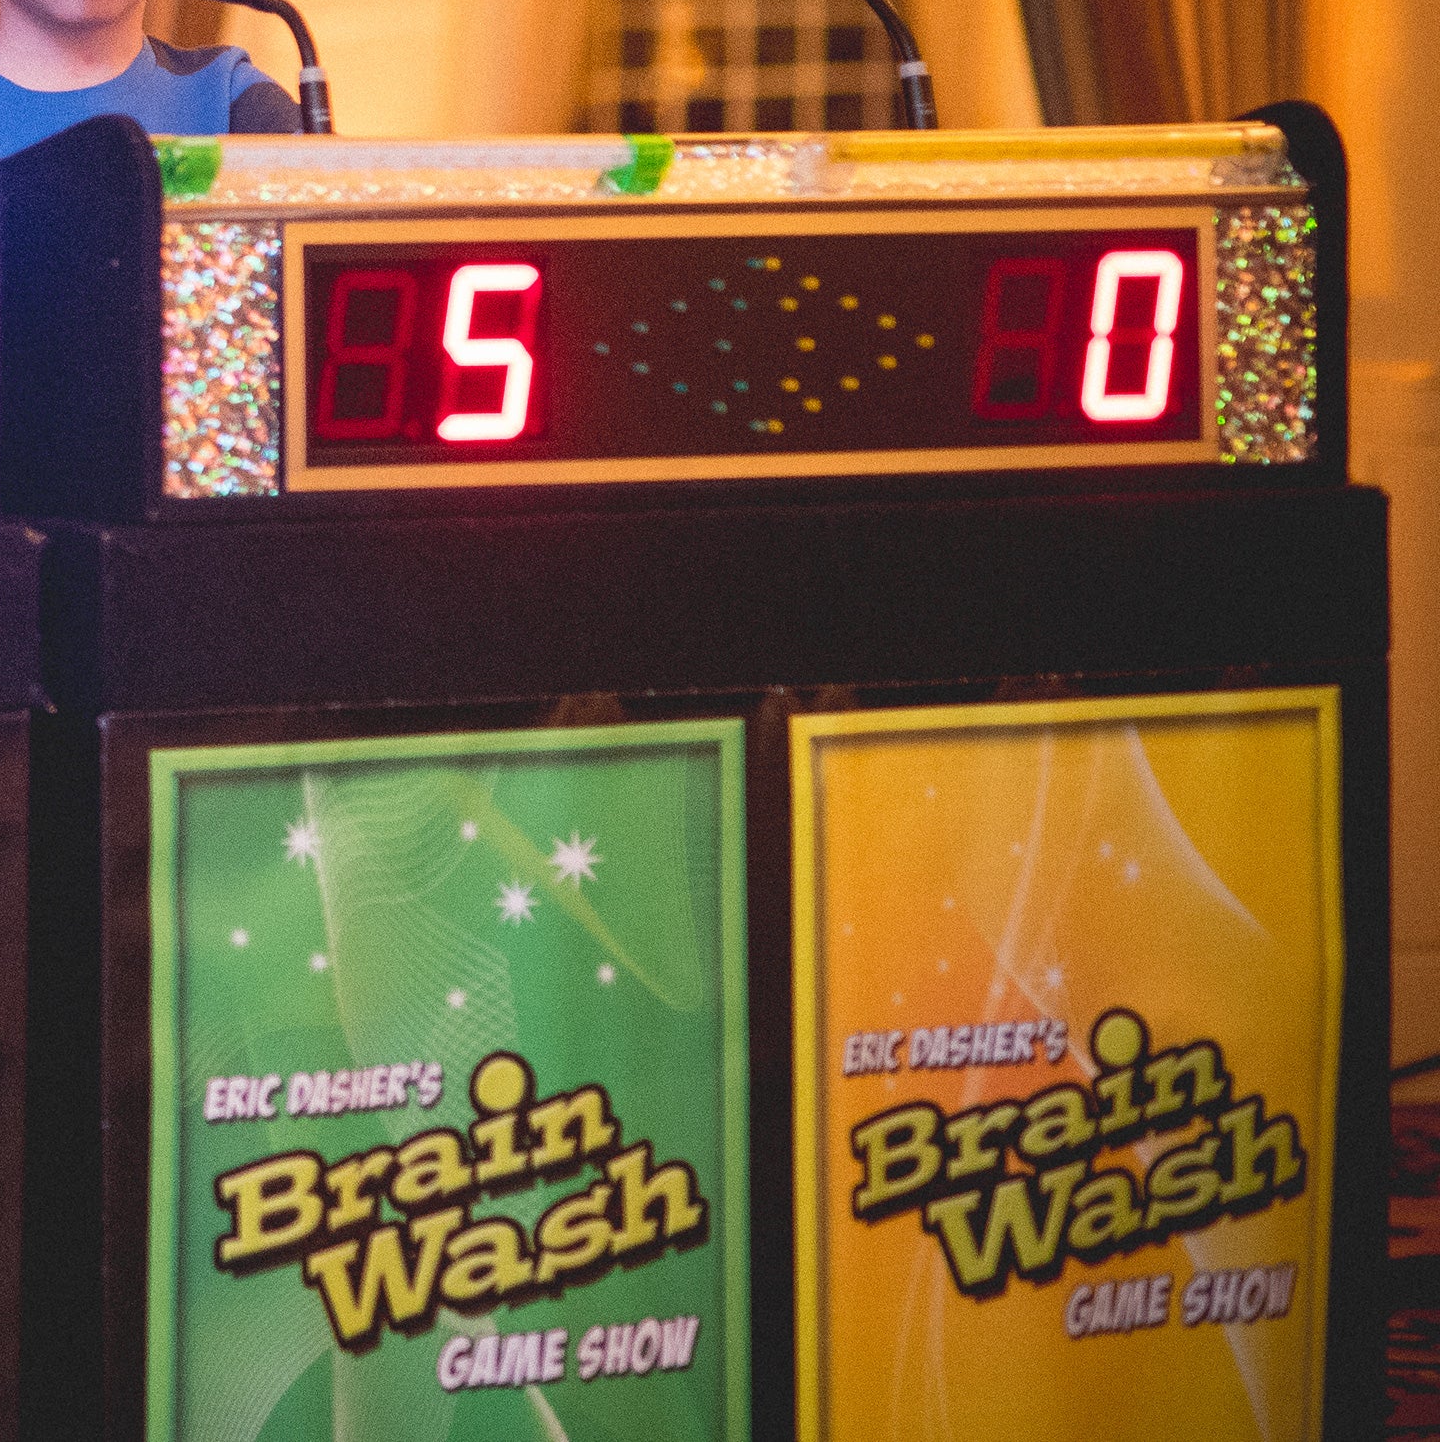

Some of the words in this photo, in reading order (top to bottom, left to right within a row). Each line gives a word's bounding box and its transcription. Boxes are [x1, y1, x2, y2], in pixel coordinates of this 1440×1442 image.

[437, 263, 541, 441] 5
[1081, 249, 1184, 422] 0
[204, 1073, 281, 1121] ERIC
[287, 1061, 443, 1115] DASHER'S
[843, 1030, 904, 1075] ERIC
[909, 1019, 1068, 1070] DASHER'S
[855, 1013, 1226, 1213] Brain
[220, 1055, 616, 1260] Brain
[308, 1147, 702, 1341] Wash
[927, 1101, 1301, 1286] Wash
[437, 1328, 568, 1390] GAME
[577, 1315, 700, 1380] SHOW
[1065, 1275, 1171, 1338] GAME
[1182, 1265, 1296, 1326] SHOW
